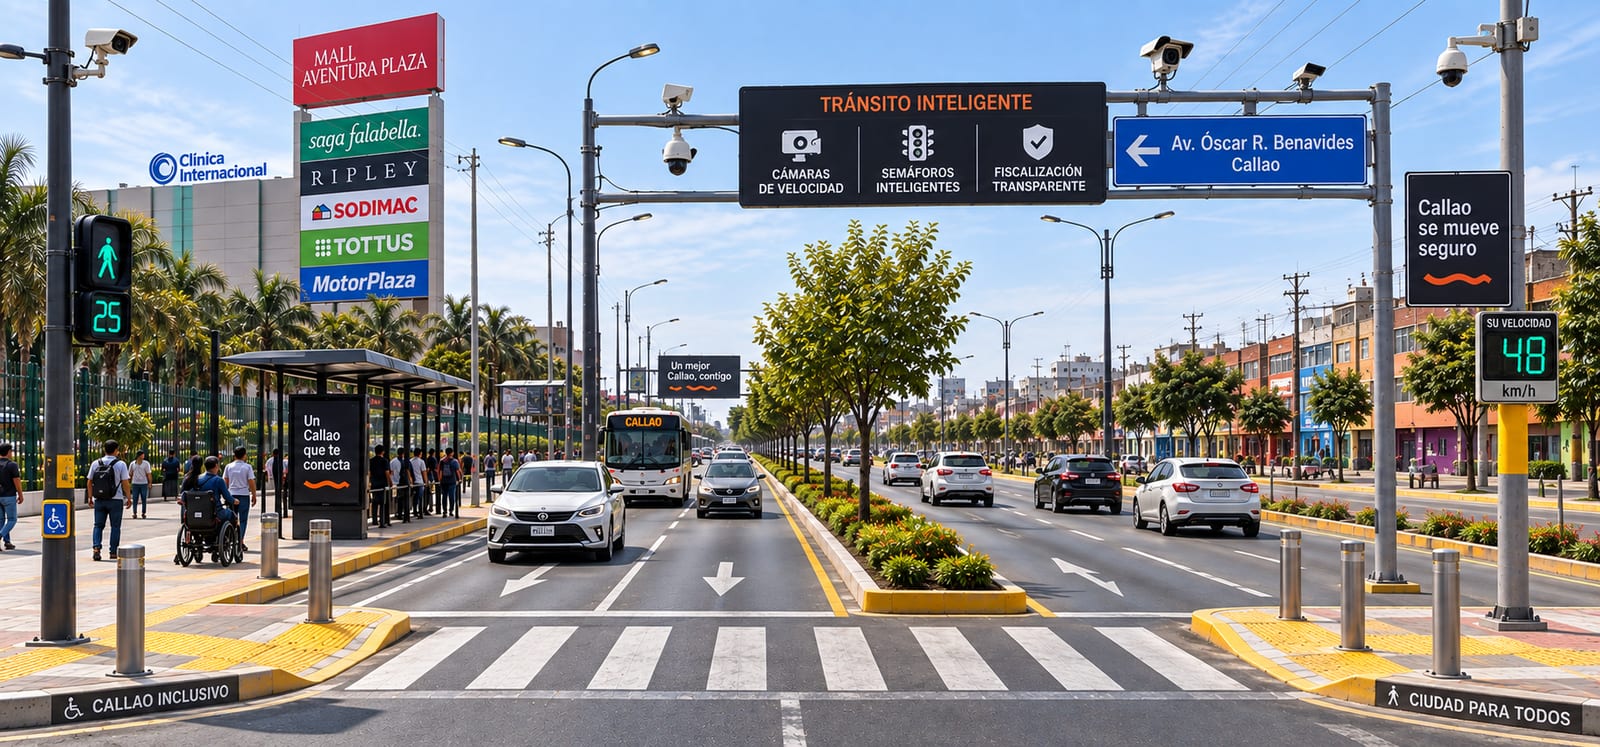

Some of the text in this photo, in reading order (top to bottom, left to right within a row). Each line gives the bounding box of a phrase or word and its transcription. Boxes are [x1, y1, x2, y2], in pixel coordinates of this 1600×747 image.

[315, 45, 356, 66] MALL
[302, 53, 427, 87] AVENTURA PLAZA
[820, 92, 1032, 112] TRÁNSITO INTELIGENTE
[308, 118, 421, 153] saga falabella.
[1172, 131, 1353, 150] Av. Óscar R. Benavides
[180, 152, 224, 166] Clínica
[1232, 157, 1279, 171] Callao
[180, 162, 267, 182] Internacional
[311, 160, 418, 186] RIPLEY
[773, 167, 830, 179] CÁMARAS
[882, 166, 954, 178] SEMÁFOROS
[995, 164, 1081, 177] FISCALIZACIÓN
[759, 183, 844, 194] DE VELOCIDAD
[877, 182, 960, 192] INTELIGENTES
[992, 181, 1085, 191] TRANSPARENTE
[333, 196, 418, 219] SODIMAC
[1419, 199, 1471, 215] Callao
[1419, 223, 1499, 235] se mueve
[334, 233, 413, 255] TOTTUS
[1419, 244, 1476, 260] seguro
[312, 271, 416, 293] MotorPlaza
[93, 300, 121, 333] 25
[1487, 319, 1551, 327] SU VELOCIDAD
[1503, 337, 1545, 374] 48
[671, 361, 711, 371] Un mejor
[667, 371, 732, 382] Callao, contigo
[1503, 384, 1535, 397] km/h
[304, 415, 320, 427] Un
[625, 417, 662, 427] CALLAO
[303, 428, 341, 442] Callao
[303, 444, 341, 459] que te
[303, 459, 351, 471] conecta
[92, 684, 229, 713] CALLAO INCLUSIVO
[1409, 692, 1571, 726] CIUDAD PARA TODOS
